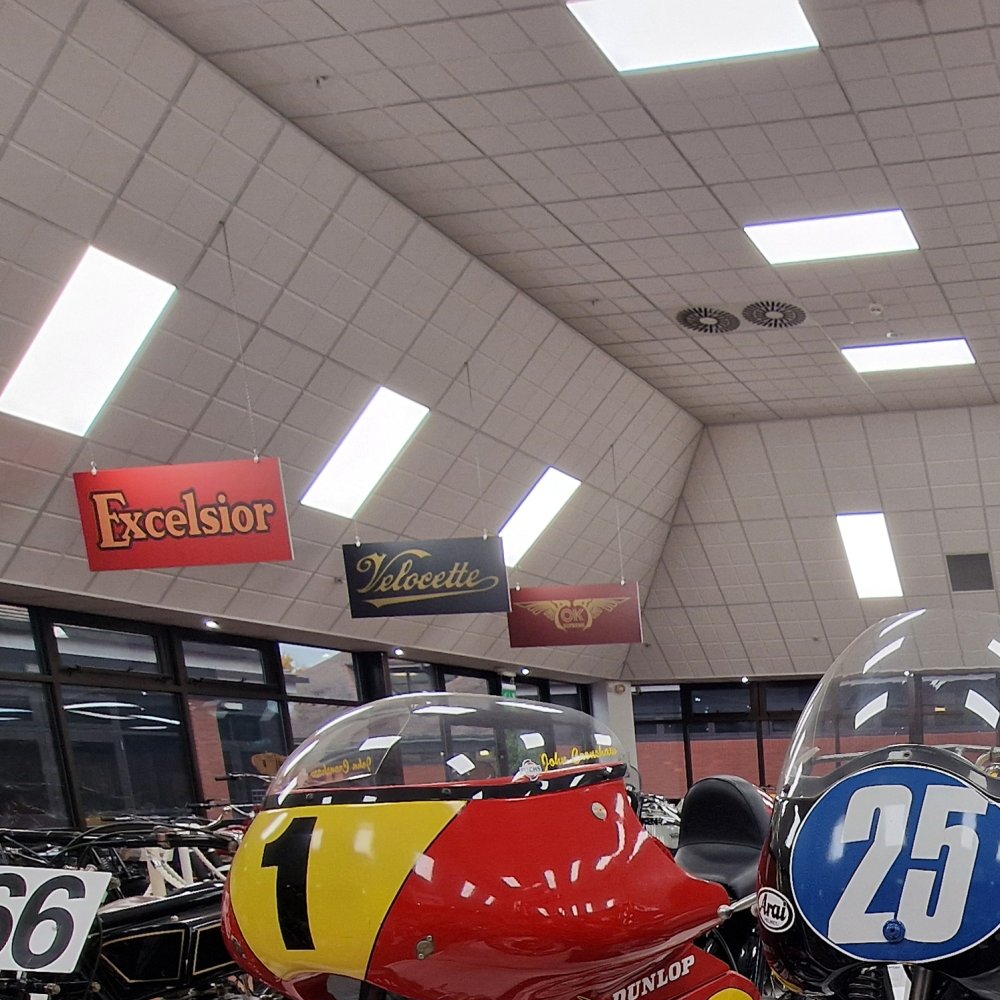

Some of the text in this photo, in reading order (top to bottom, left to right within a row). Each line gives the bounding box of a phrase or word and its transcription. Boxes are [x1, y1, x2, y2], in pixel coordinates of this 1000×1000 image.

[94, 489, 277, 550] Excelsior
[356, 549, 499, 596] Velocette
[560, 607, 584, 623] OK
[262, 816, 316, 950] 1
[828, 785, 990, 944] 25
[759, 893, 787, 921] Arai
